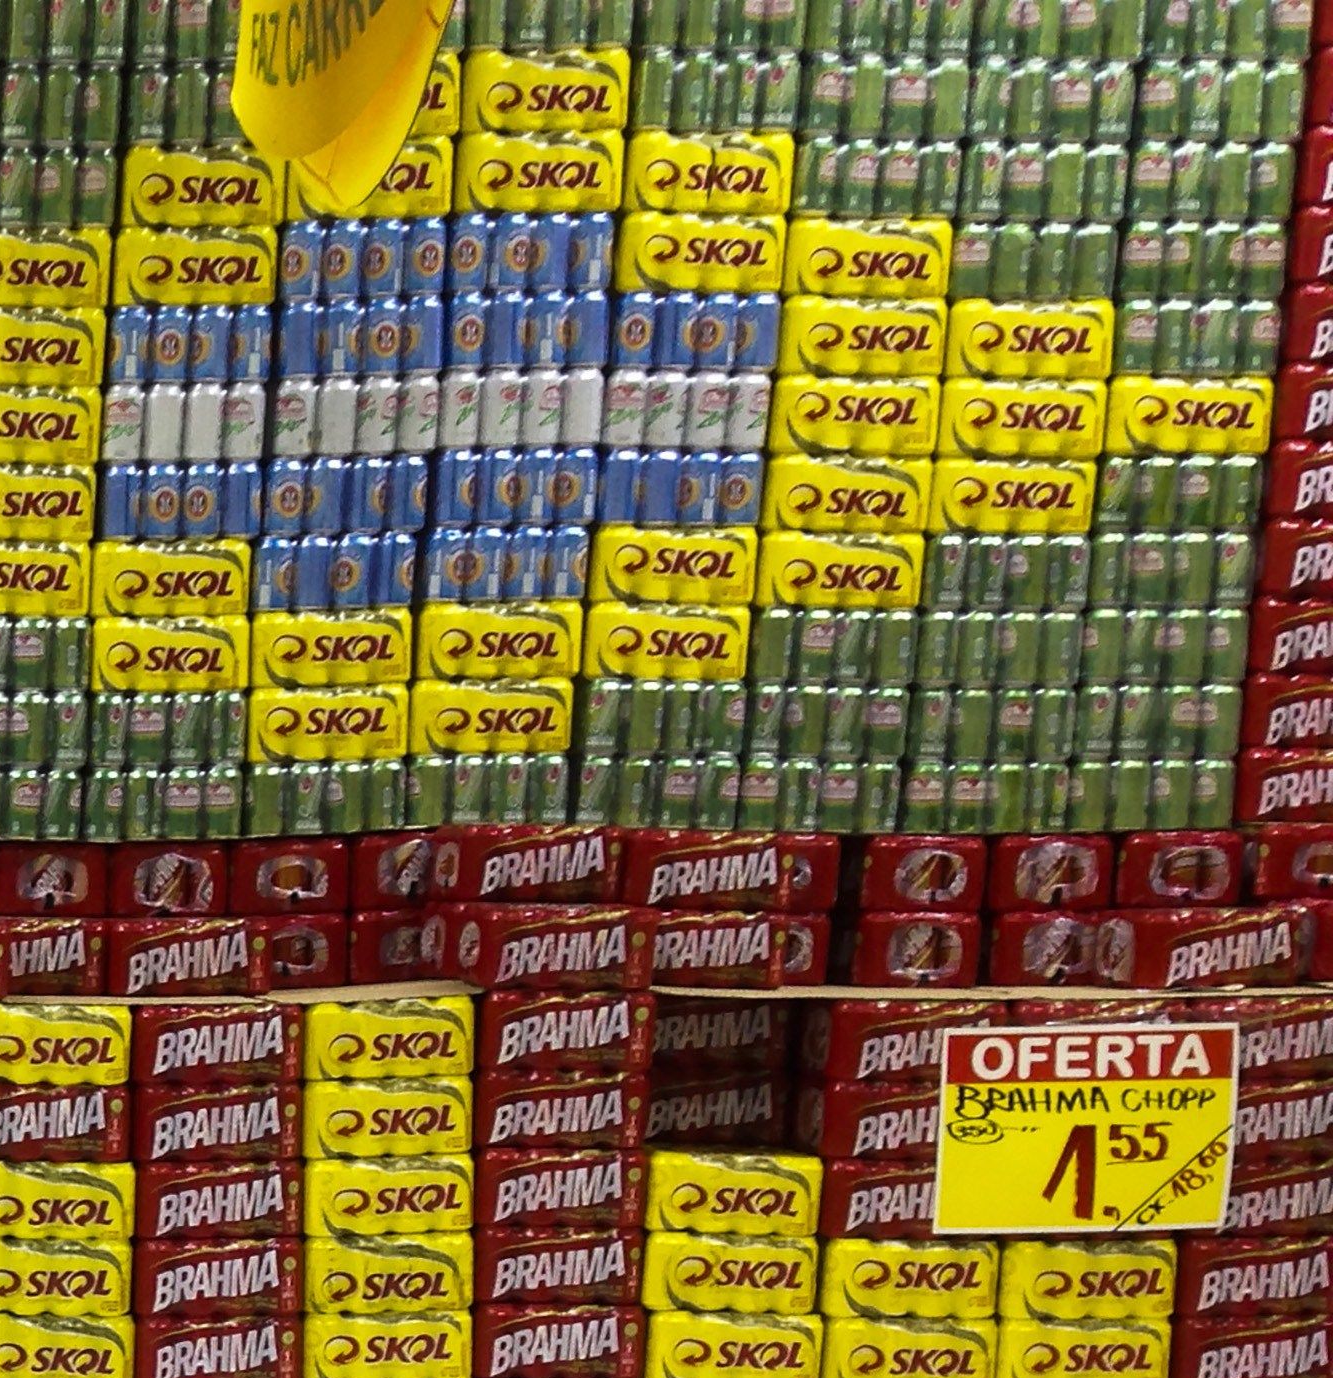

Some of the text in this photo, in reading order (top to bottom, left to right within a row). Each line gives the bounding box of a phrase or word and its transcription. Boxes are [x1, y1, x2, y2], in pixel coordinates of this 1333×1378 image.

[527, 85, 610, 113] SKOL
[685, 161, 767, 199] SKOL
[8, 259, 86, 288] SKOL
[850, 326, 931, 353] SKOL
[1173, 400, 1254, 429] SKOL
[994, 481, 1074, 510] SKOL
[154, 571, 233, 598] SKOL
[822, 564, 901, 592] SKOL
[647, 630, 729, 660] SKOL
[306, 708, 387, 735] SKOL
[648, 848, 777, 904] BRAHMA
[127, 931, 248, 994] BRAHMA
[495, 925, 625, 982] BRAHMA
[1166, 922, 1291, 986] BRAHMA
[33, 1037, 115, 1066] SKOL
[971, 1033, 1212, 1080] OFERTA
[954, 1085, 1217, 1119] BRAHMA CHOPP
[151, 1097, 280, 1159] BRAHMA
[373, 1105, 455, 1135] SKOL
[31, 1199, 112, 1226] SKOL
[713, 1188, 797, 1216] SKOL
[153, 1250, 279, 1312] BRAHMA
[492, 1241, 625, 1297] BRAHMA
[1197, 1252, 1329, 1310] BRAHMA
[368, 1333, 451, 1362] SKOL
[890, 1349, 975, 1377] SKOL
